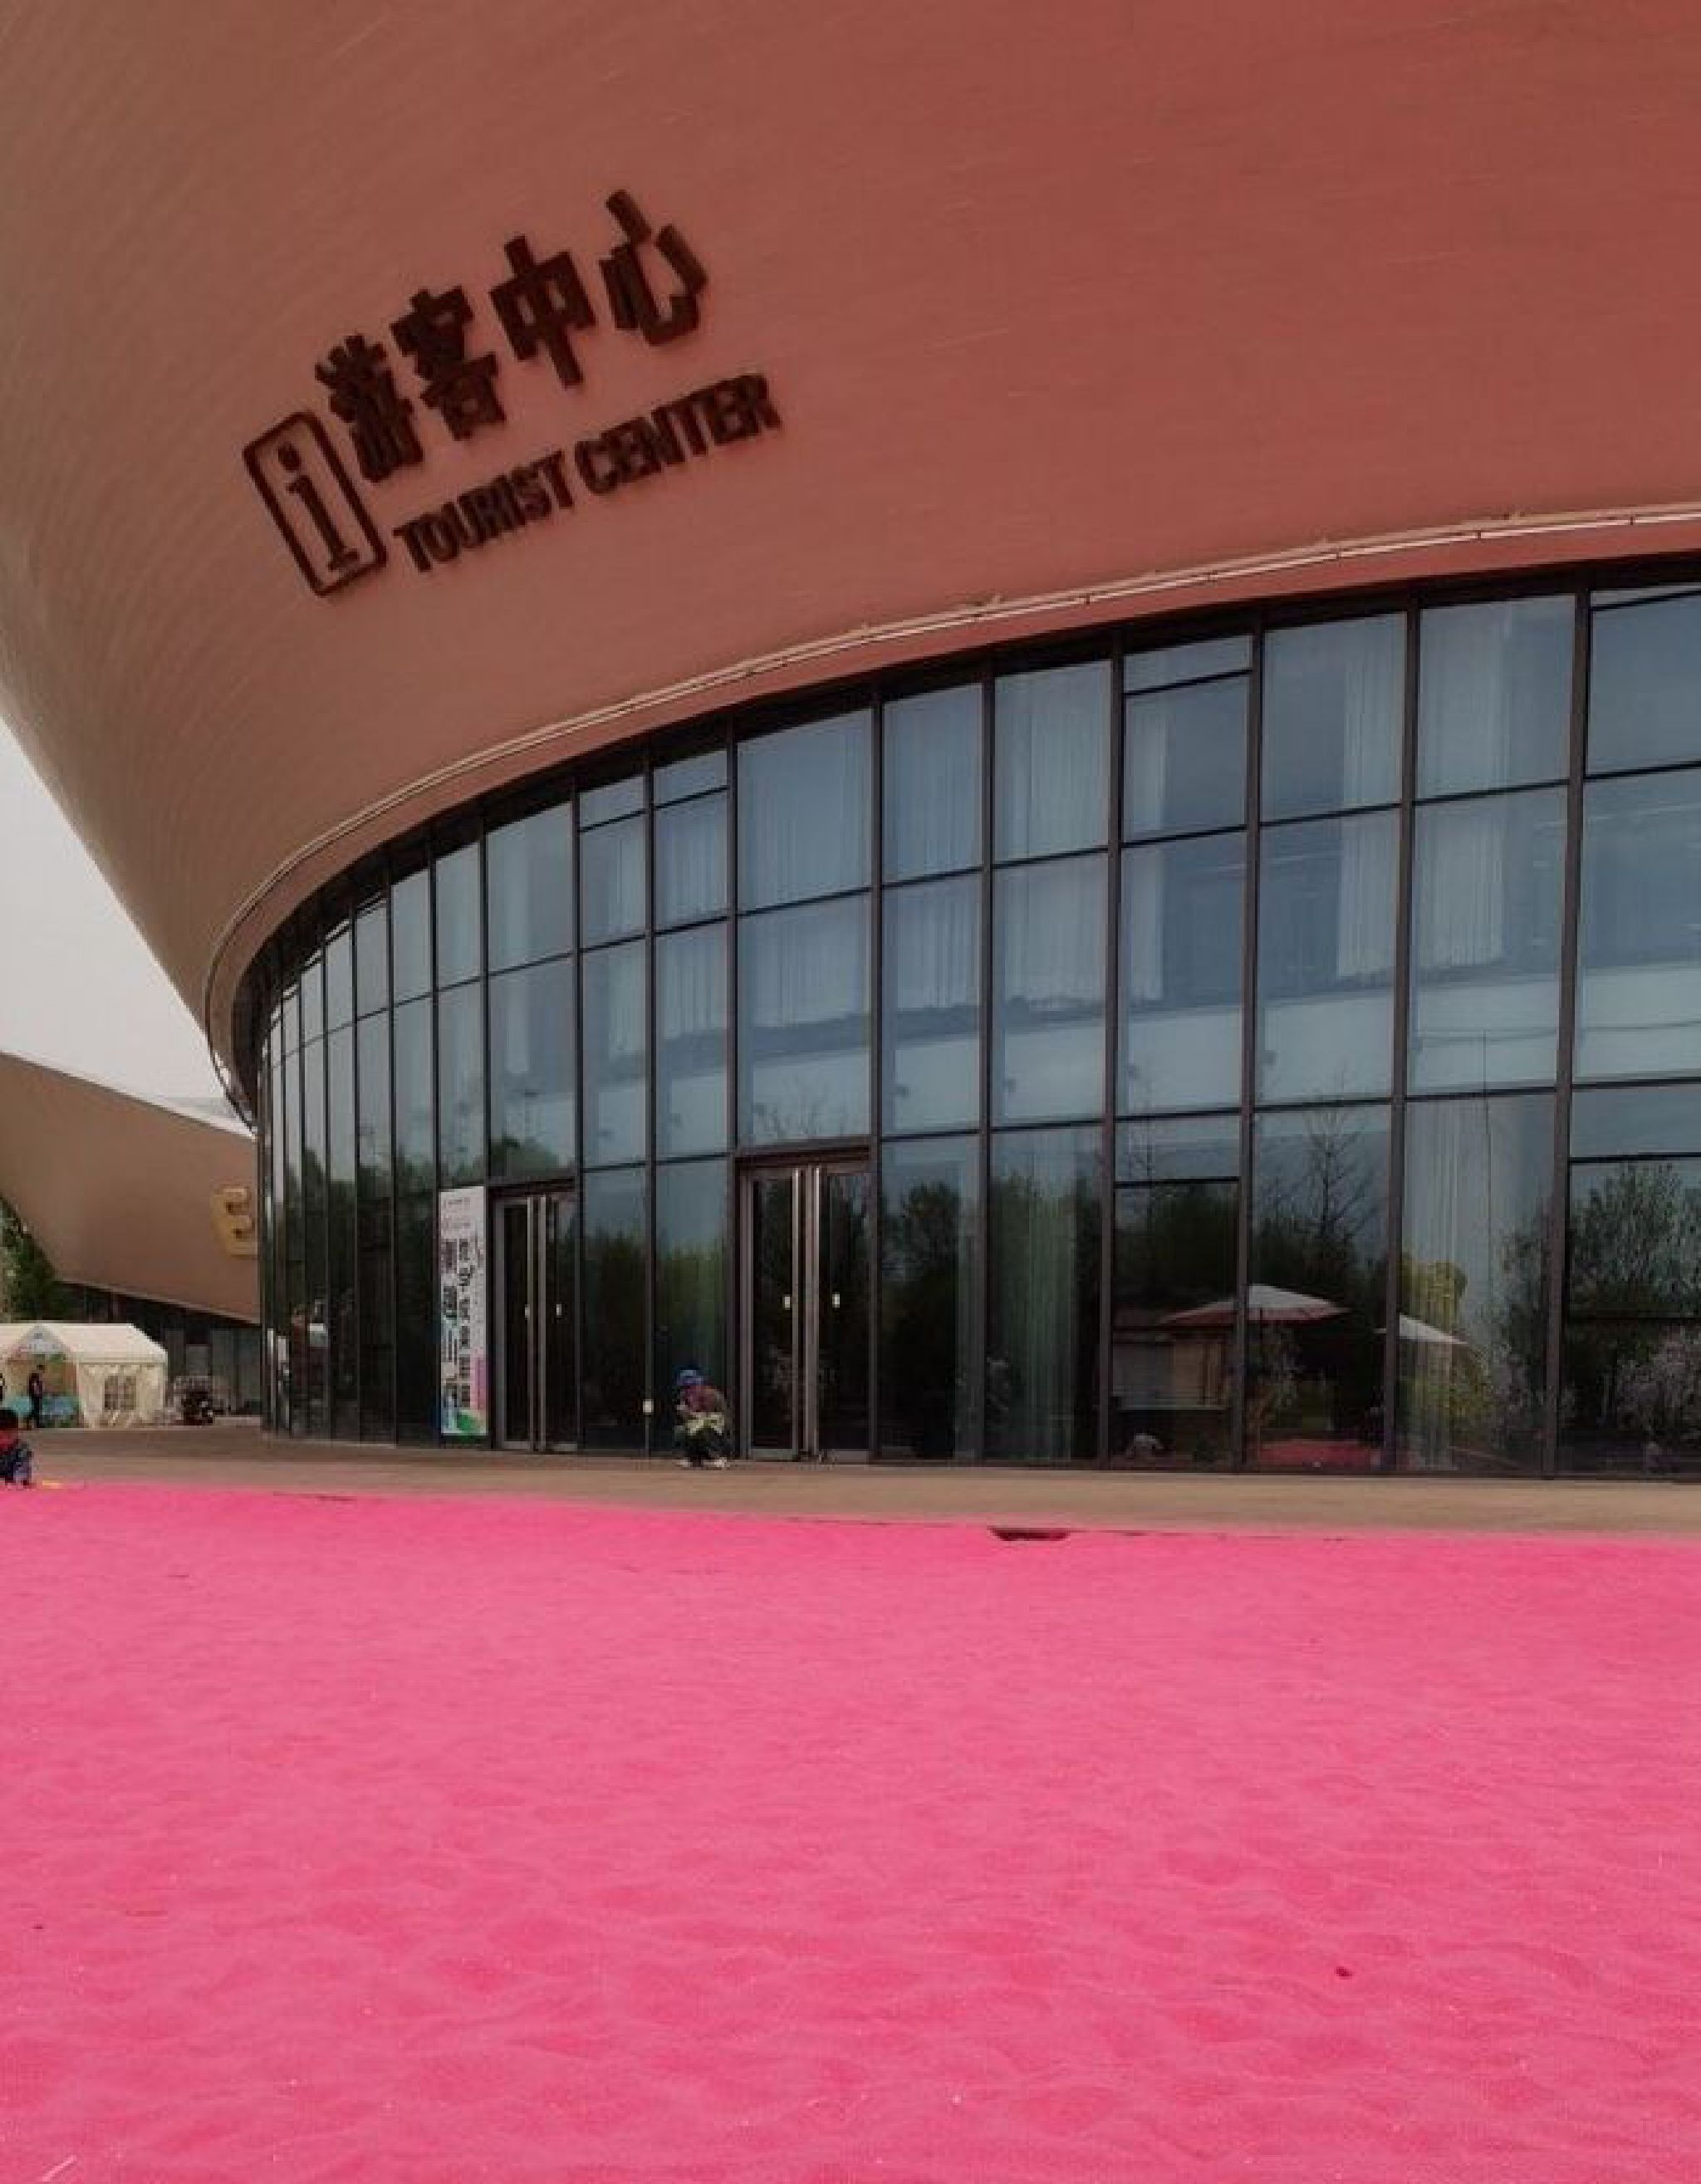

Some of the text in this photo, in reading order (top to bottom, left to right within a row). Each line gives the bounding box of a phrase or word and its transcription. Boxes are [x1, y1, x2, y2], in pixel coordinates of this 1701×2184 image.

[315, 189, 708, 483] 游客中心
[392, 373, 781, 573] TOURIST CENTER
